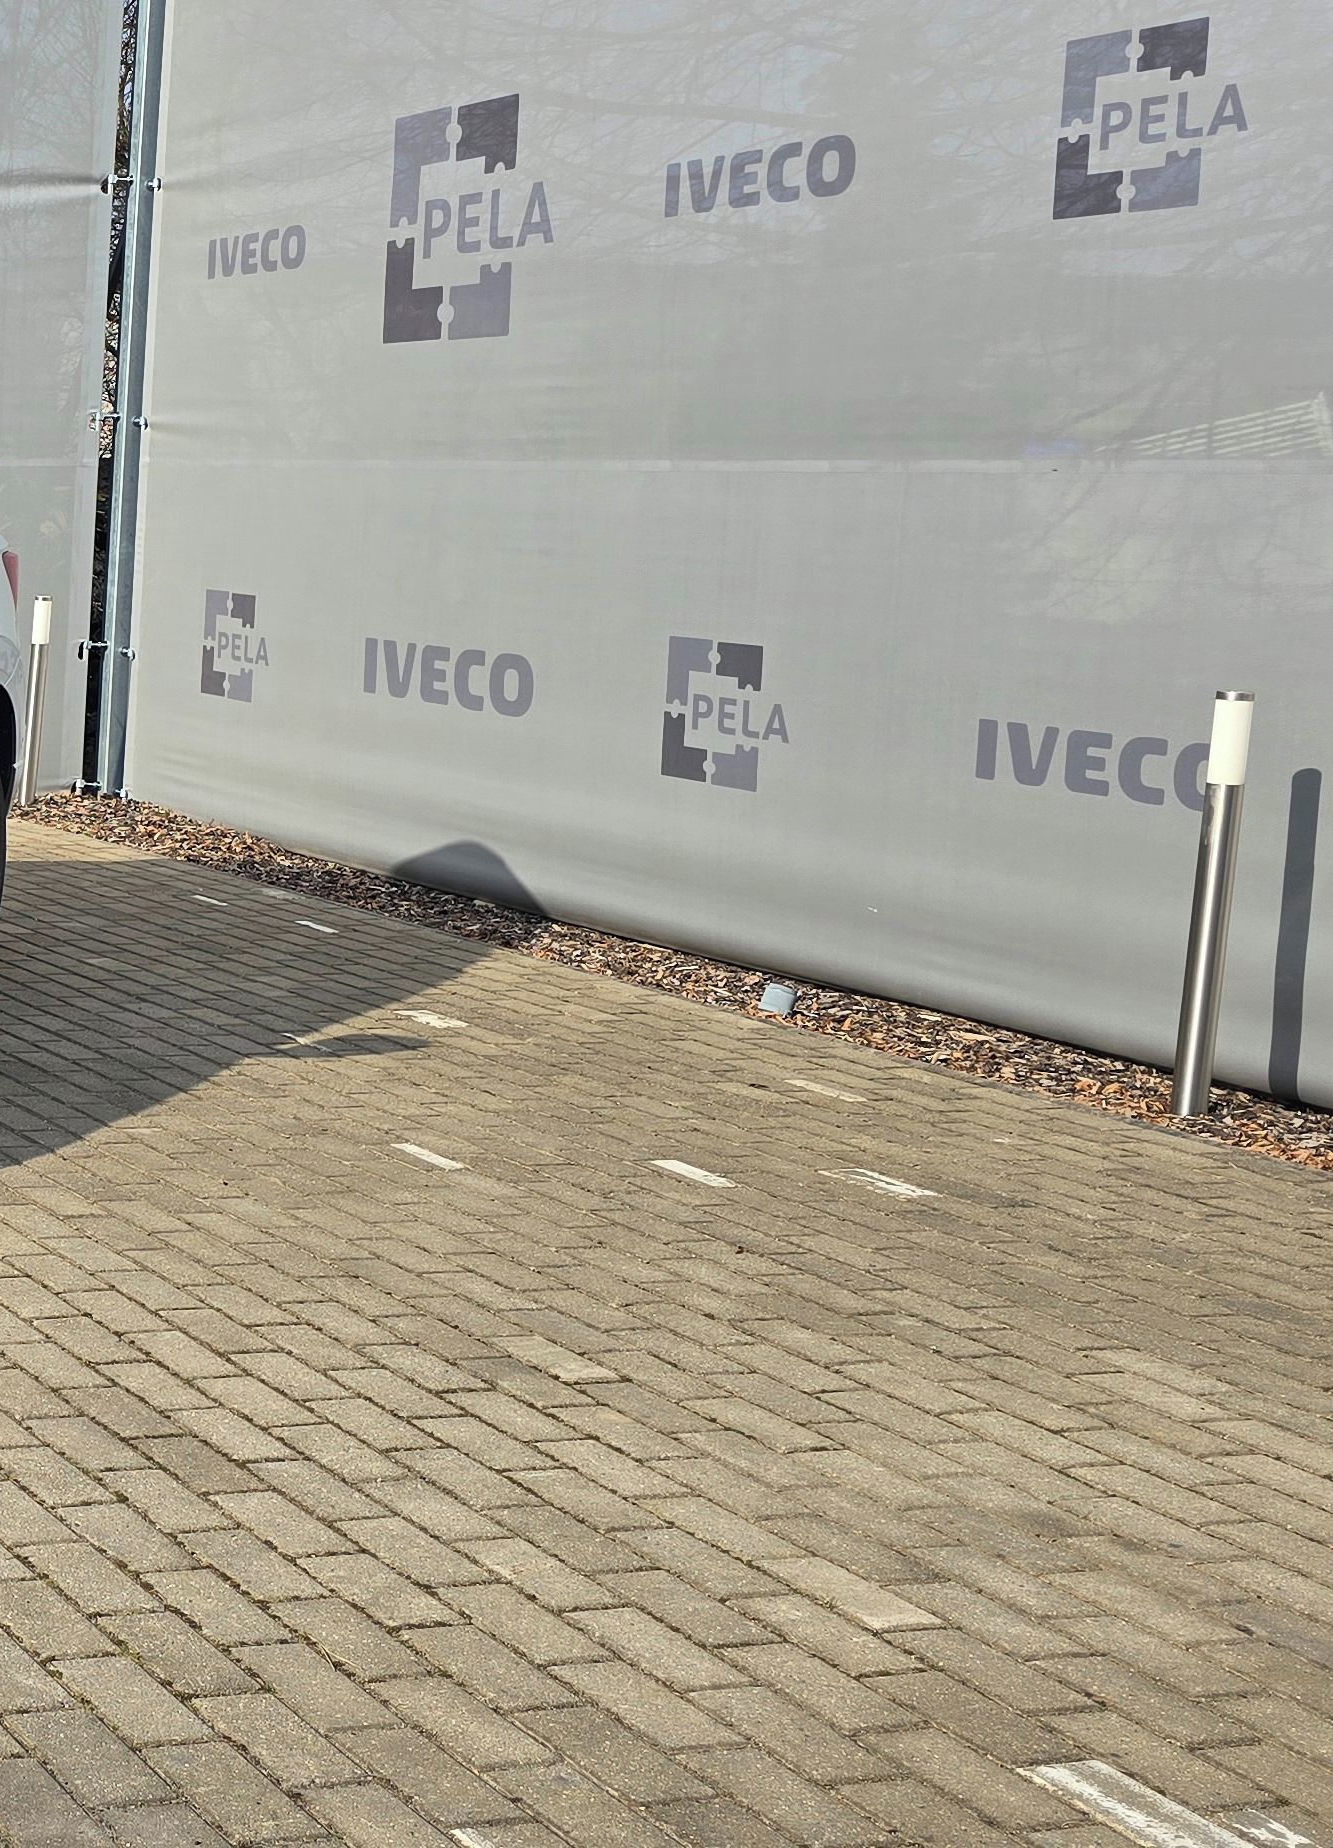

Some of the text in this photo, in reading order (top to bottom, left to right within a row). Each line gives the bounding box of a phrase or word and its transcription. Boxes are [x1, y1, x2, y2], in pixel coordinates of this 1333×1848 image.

[1100, 84, 1248, 150] PELA
[665, 135, 856, 217] IVECO
[208, 225, 306, 279] IVECO
[423, 181, 554, 259] PELA
[218, 632, 268, 666] PELA
[364, 638, 534, 717] IVECO
[692, 694, 789, 743] PELA
